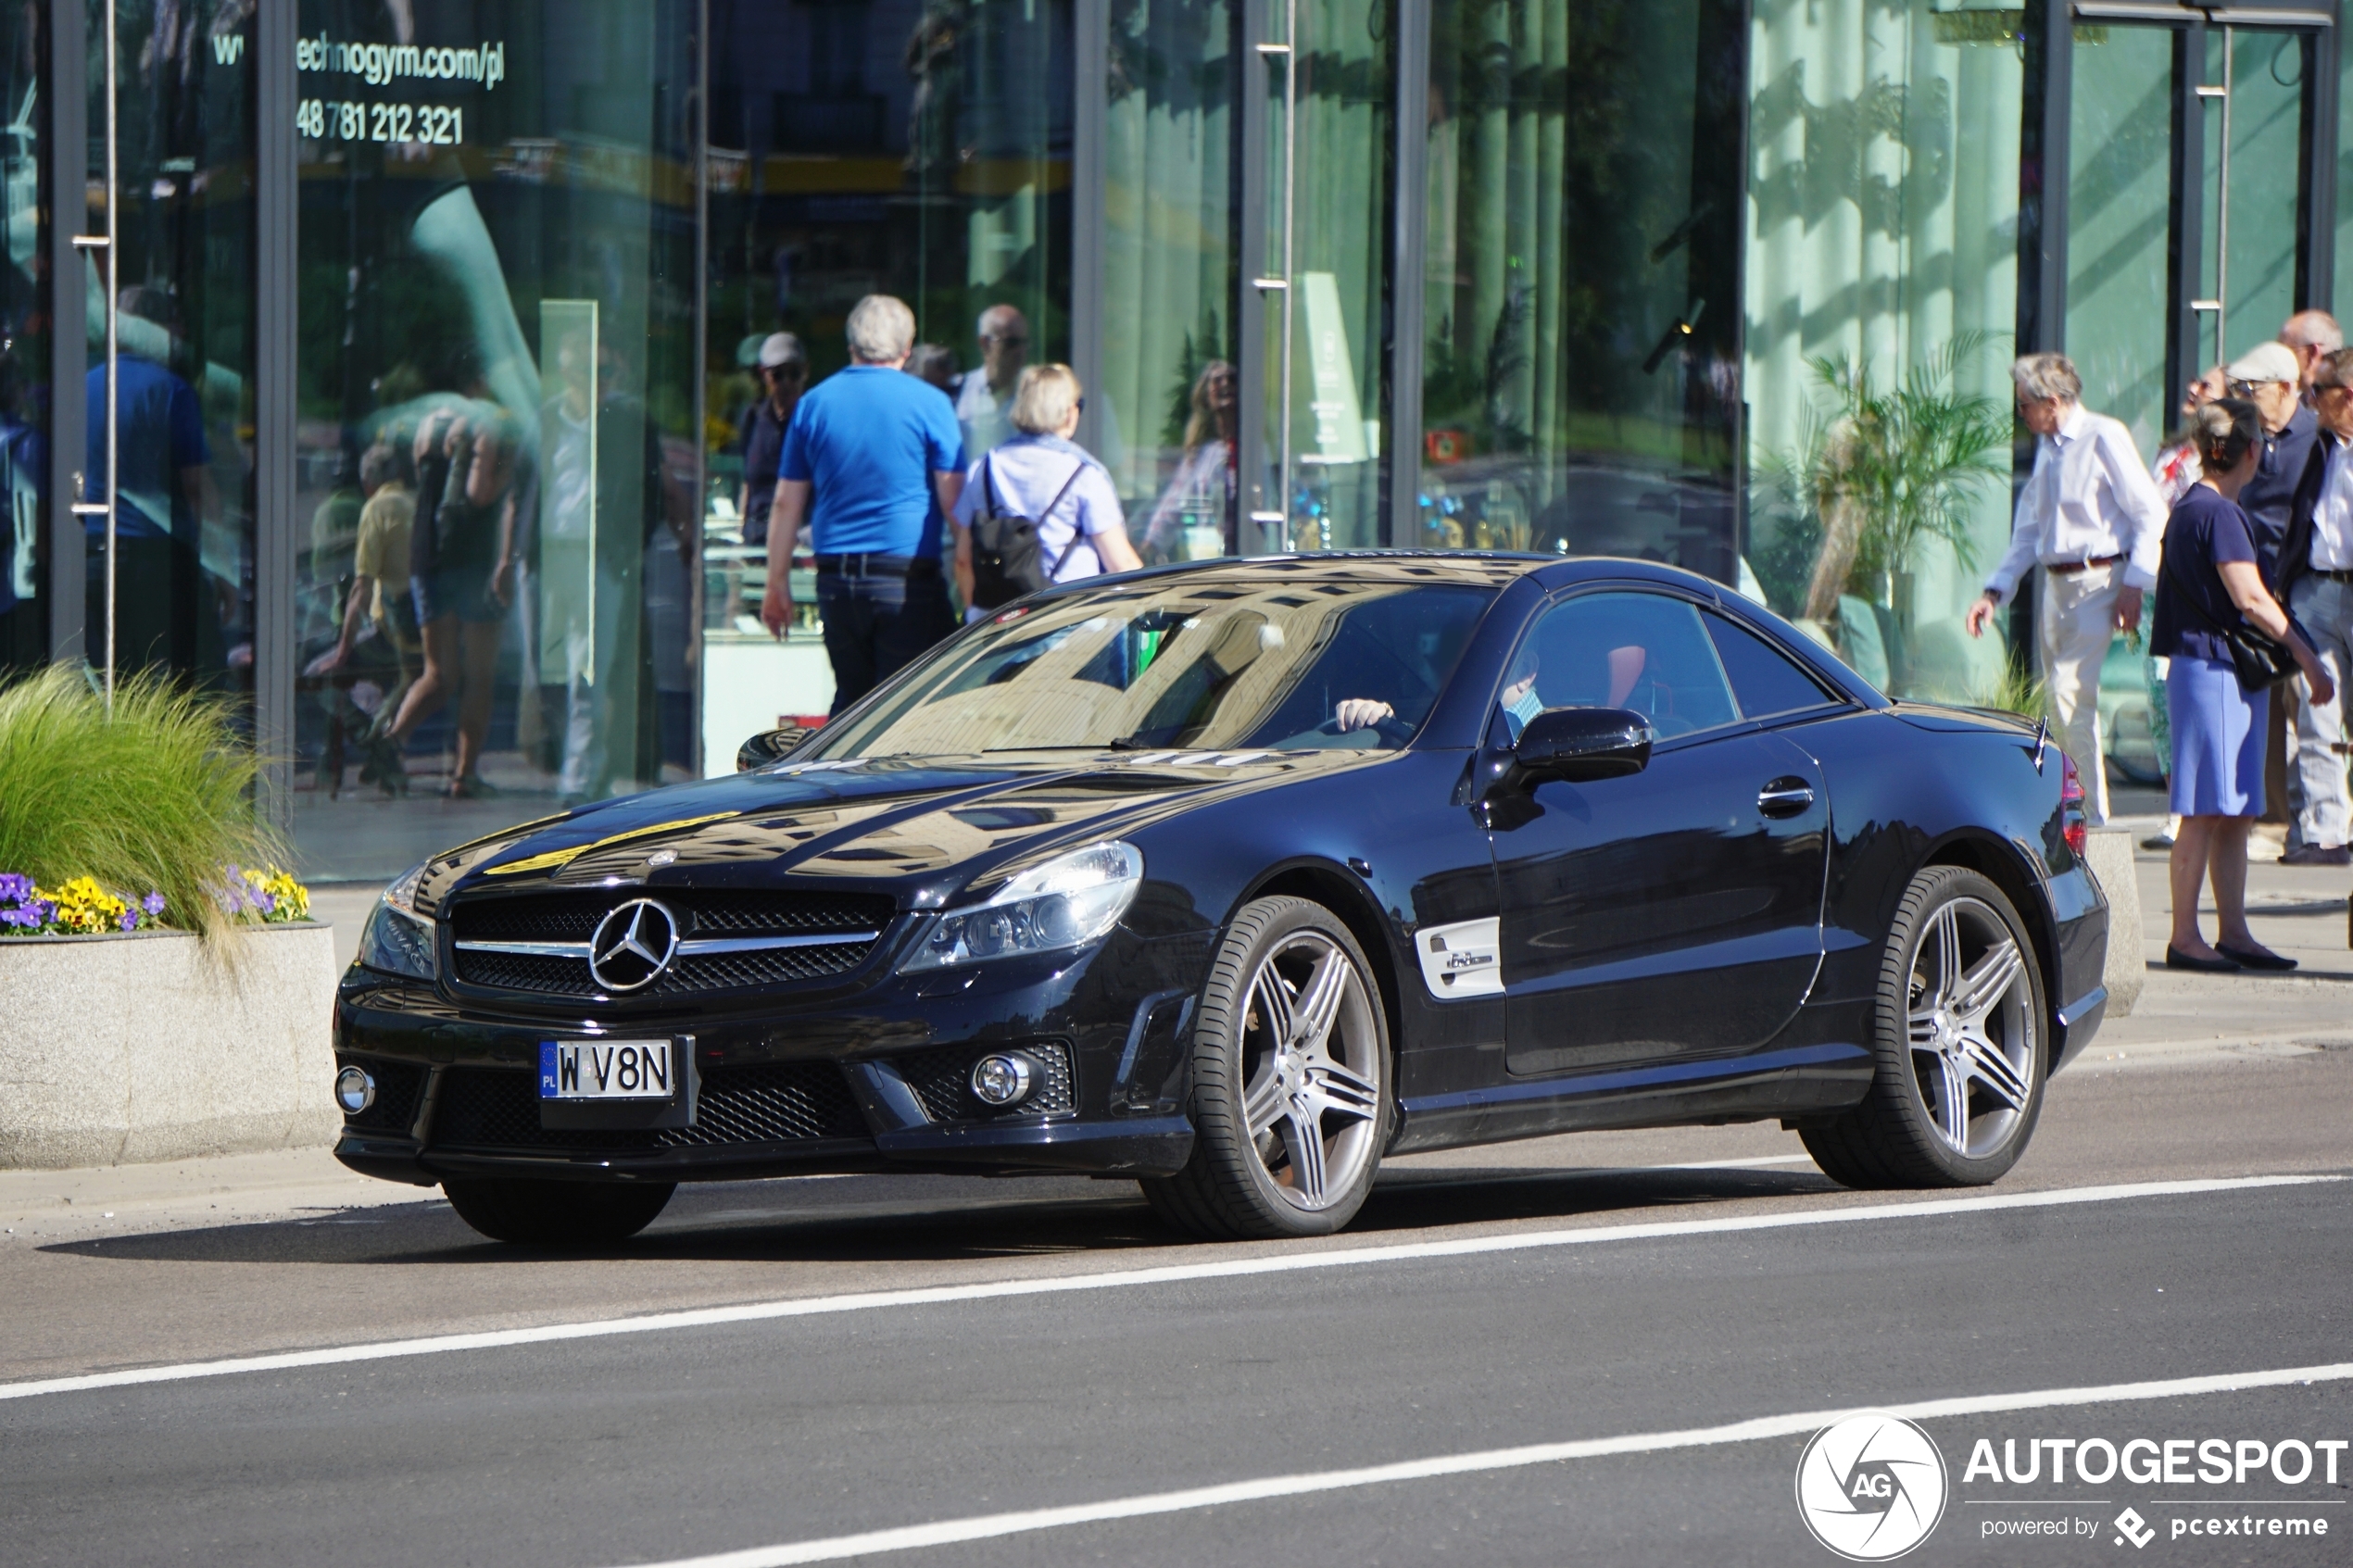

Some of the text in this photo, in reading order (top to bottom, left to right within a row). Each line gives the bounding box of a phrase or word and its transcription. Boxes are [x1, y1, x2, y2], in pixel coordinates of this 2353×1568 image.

[326, 100, 366, 140] 781
[371, 102, 413, 143] 212
[417, 105, 462, 144] 321
[543, 1075, 556, 1088] PL
[560, 1046, 668, 1091] W V8N
